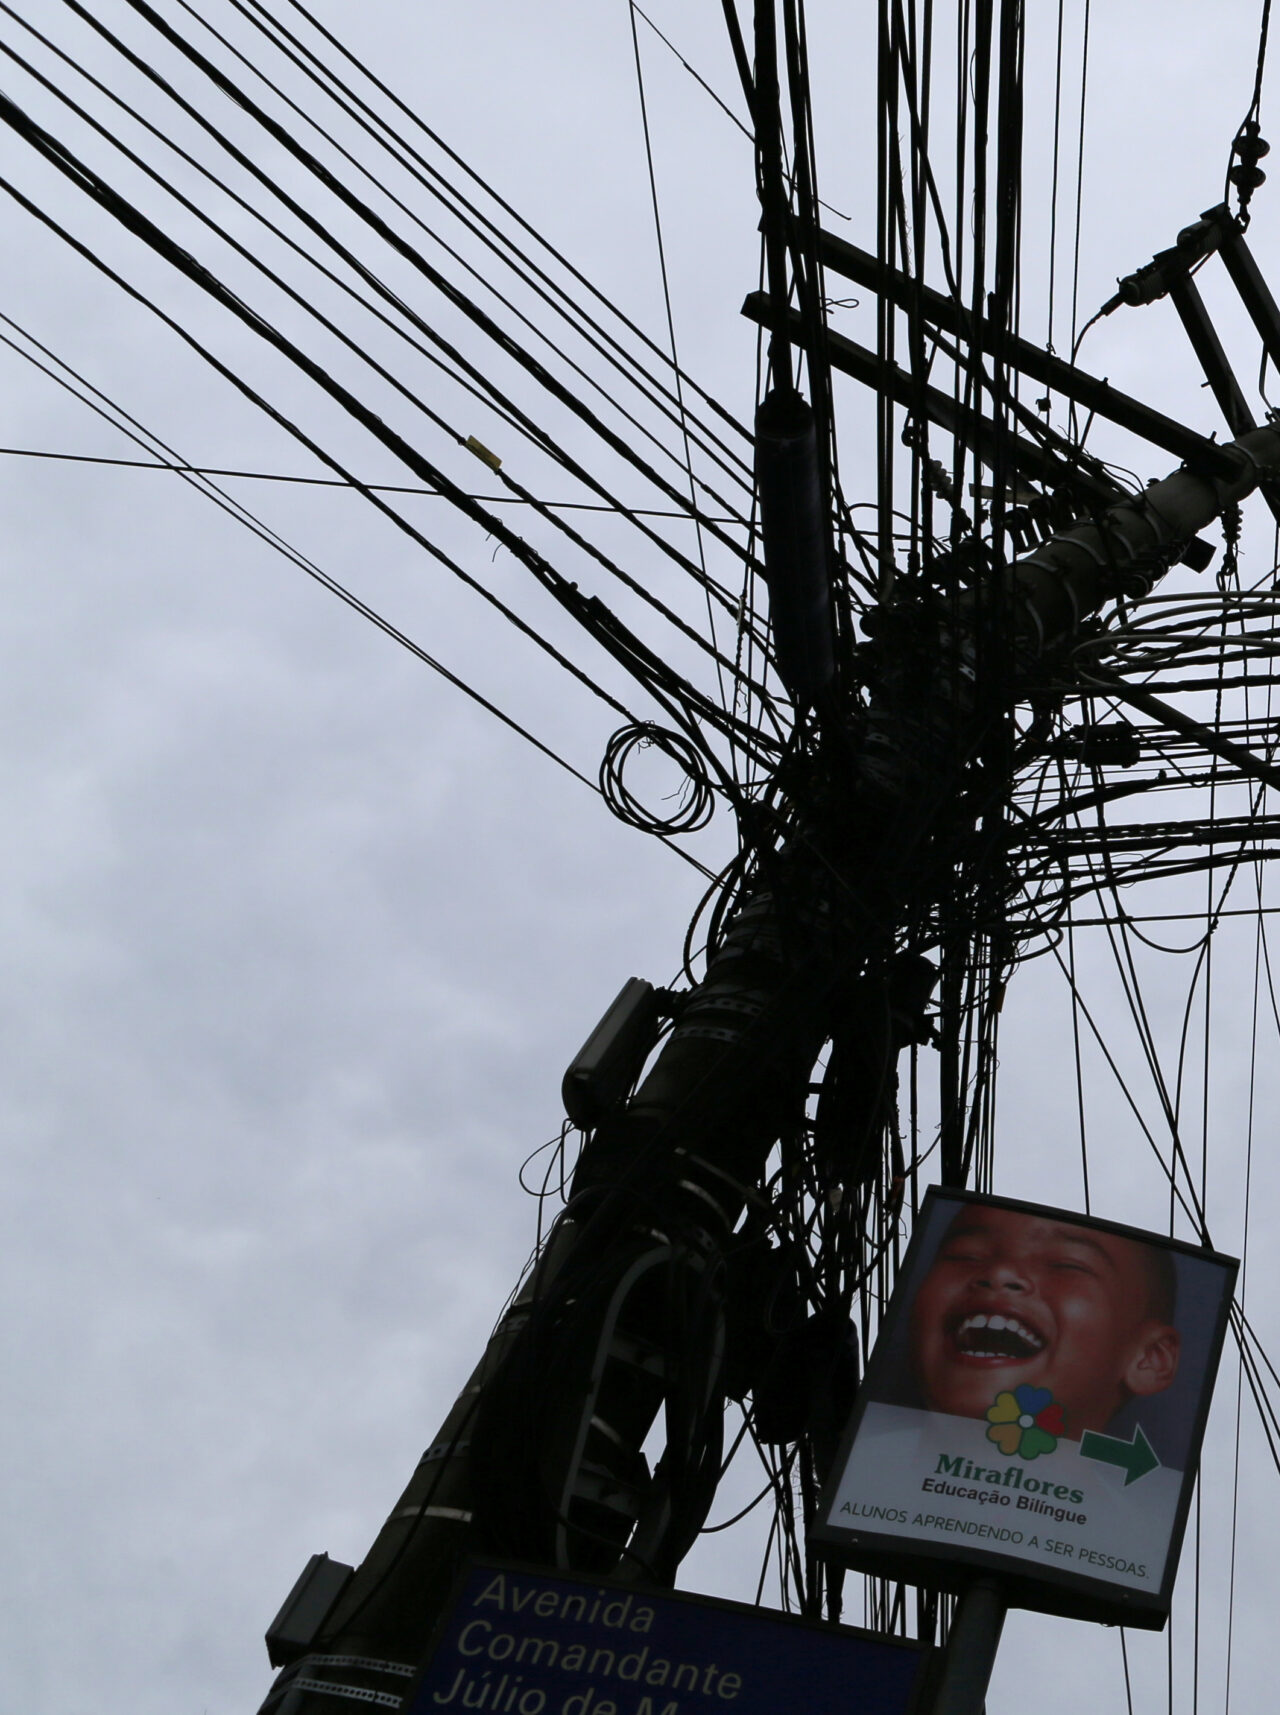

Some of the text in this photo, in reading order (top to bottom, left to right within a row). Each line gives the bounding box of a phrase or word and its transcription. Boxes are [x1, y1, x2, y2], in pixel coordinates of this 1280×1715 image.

[922, 1478, 1087, 1525] Educação Bilíngue
[934, 1454, 1085, 1503] Miraflores
[840, 1501, 1150, 1579] ALUNOS APRENDENDO A SER PESSOAS.
[472, 1573, 656, 1633] Avenida
[457, 1619, 743, 1700] Comandante
[432, 1668, 547, 1715] Júlio
[561, 1688, 617, 1715] de
